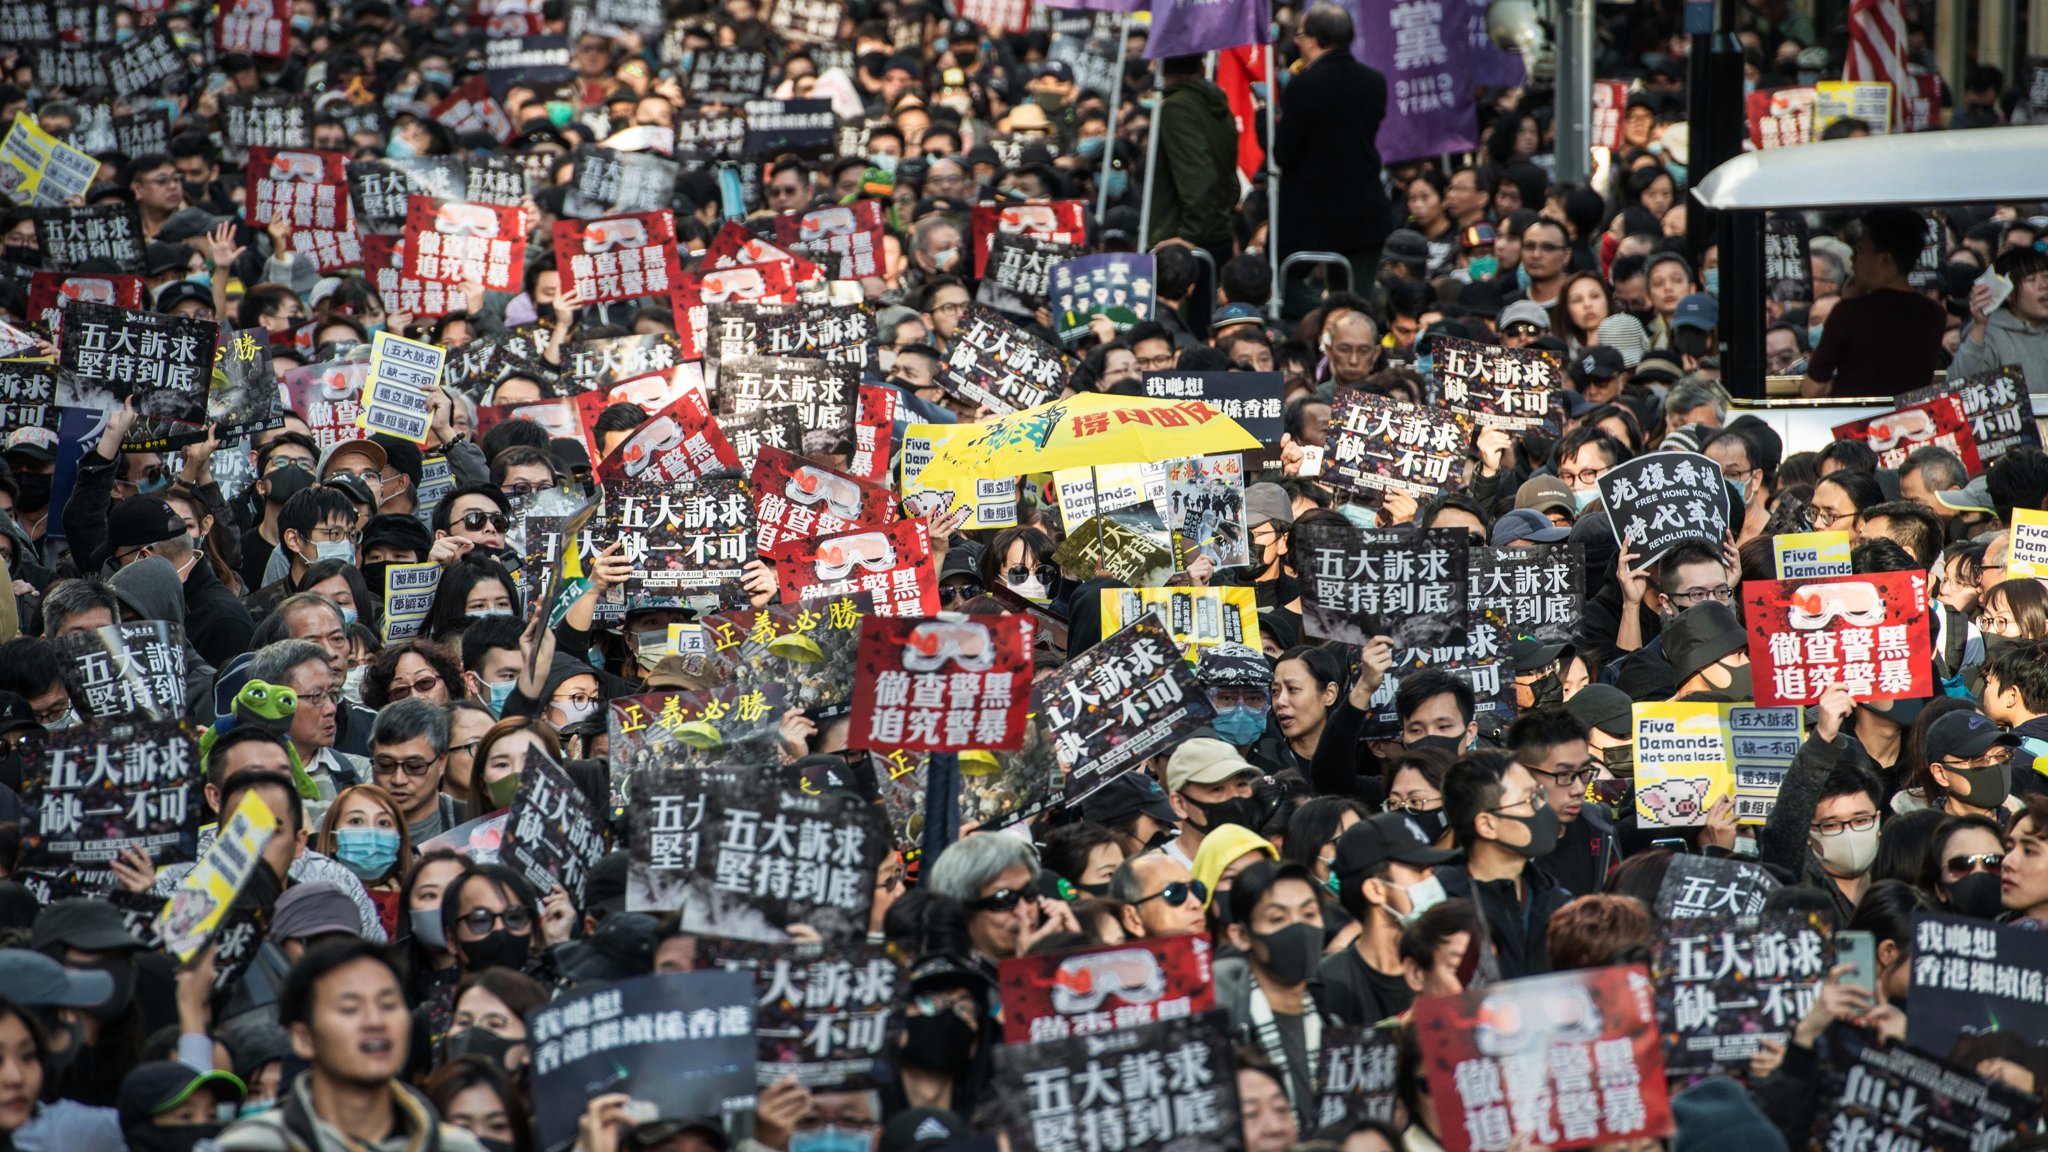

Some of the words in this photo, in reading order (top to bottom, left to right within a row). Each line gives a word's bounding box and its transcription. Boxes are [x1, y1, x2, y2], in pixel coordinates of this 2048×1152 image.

[569, 244, 667, 278] 徹查警黑
[573, 265, 669, 300] 追究警暴
[78, 322, 199, 363] 五大訴求
[767, 312, 868, 354] 五大訴求
[964, 316, 1063, 387] 五大訴求
[75, 350, 196, 392] 堅持到底
[386, 364, 433, 387] 缺一不可
[390, 343, 437, 367] 五大訴求
[572, 343, 674, 379] 五大訴求
[949, 342, 1048, 409] 缺一不可
[1443, 347, 1551, 388] 五大訴求
[378, 387, 428, 407] 獨立調查
[736, 372, 845, 404] 五大訴求
[1146, 376, 1204, 398] 我哋想
[1443, 376, 1551, 417] 缺一不可
[307, 399, 360, 428] 徹查
[374, 409, 421, 435] 重組警隊
[1341, 403, 1460, 453] 五大訴求
[905, 437, 931, 453] Five
[1334, 431, 1454, 484] 缺一不可
[1061, 480, 1094, 497] Five
[1064, 487, 1137, 511] Demands,
[1610, 459, 1721, 510] 光復香港
[1634, 495, 1660, 510] FREE
[1661, 490, 1687, 502] HONG
[1687, 490, 1713, 503] KONG
[616, 494, 749, 530] 五大訴求
[1623, 498, 1727, 546] 時代革命
[614, 530, 749, 567] 缺一不可
[1648, 528, 1702, 552] REVOLUTION
[1782, 550, 1817, 562] Five
[1314, 547, 1451, 583] 五大訴求
[1316, 579, 1451, 616] 堅持到底
[714, 594, 865, 652] 正義必勝
[1769, 623, 1912, 667] 徹查警黑
[875, 670, 1013, 709] 徹查警黑
[1772, 659, 1912, 700] 追究警暴
[619, 688, 774, 735] 正義必勝
[867, 706, 1009, 747] 追究警暴
[1639, 719, 1675, 734] Five
[1740, 710, 1795, 729] 五大訴求
[41, 736, 190, 791] 五大訴求
[1640, 751, 1665, 763] Not
[1667, 752, 1689, 763] one
[1742, 738, 1796, 756] 缺一不可
[39, 783, 190, 830] 缺一不可
[719, 807, 867, 867] 五大訴求
[714, 848, 864, 909] 堅持到底
[1671, 928, 1824, 982] 五大訴求
[1916, 919, 1998, 960] 我哋想
[714, 956, 898, 1009] 大訴求
[1915, 954, 2048, 1003] 香港繼續係
[1023, 1041, 1214, 1113] 五大訴求
[1028, 1090, 1221, 1152] 堅持到底
